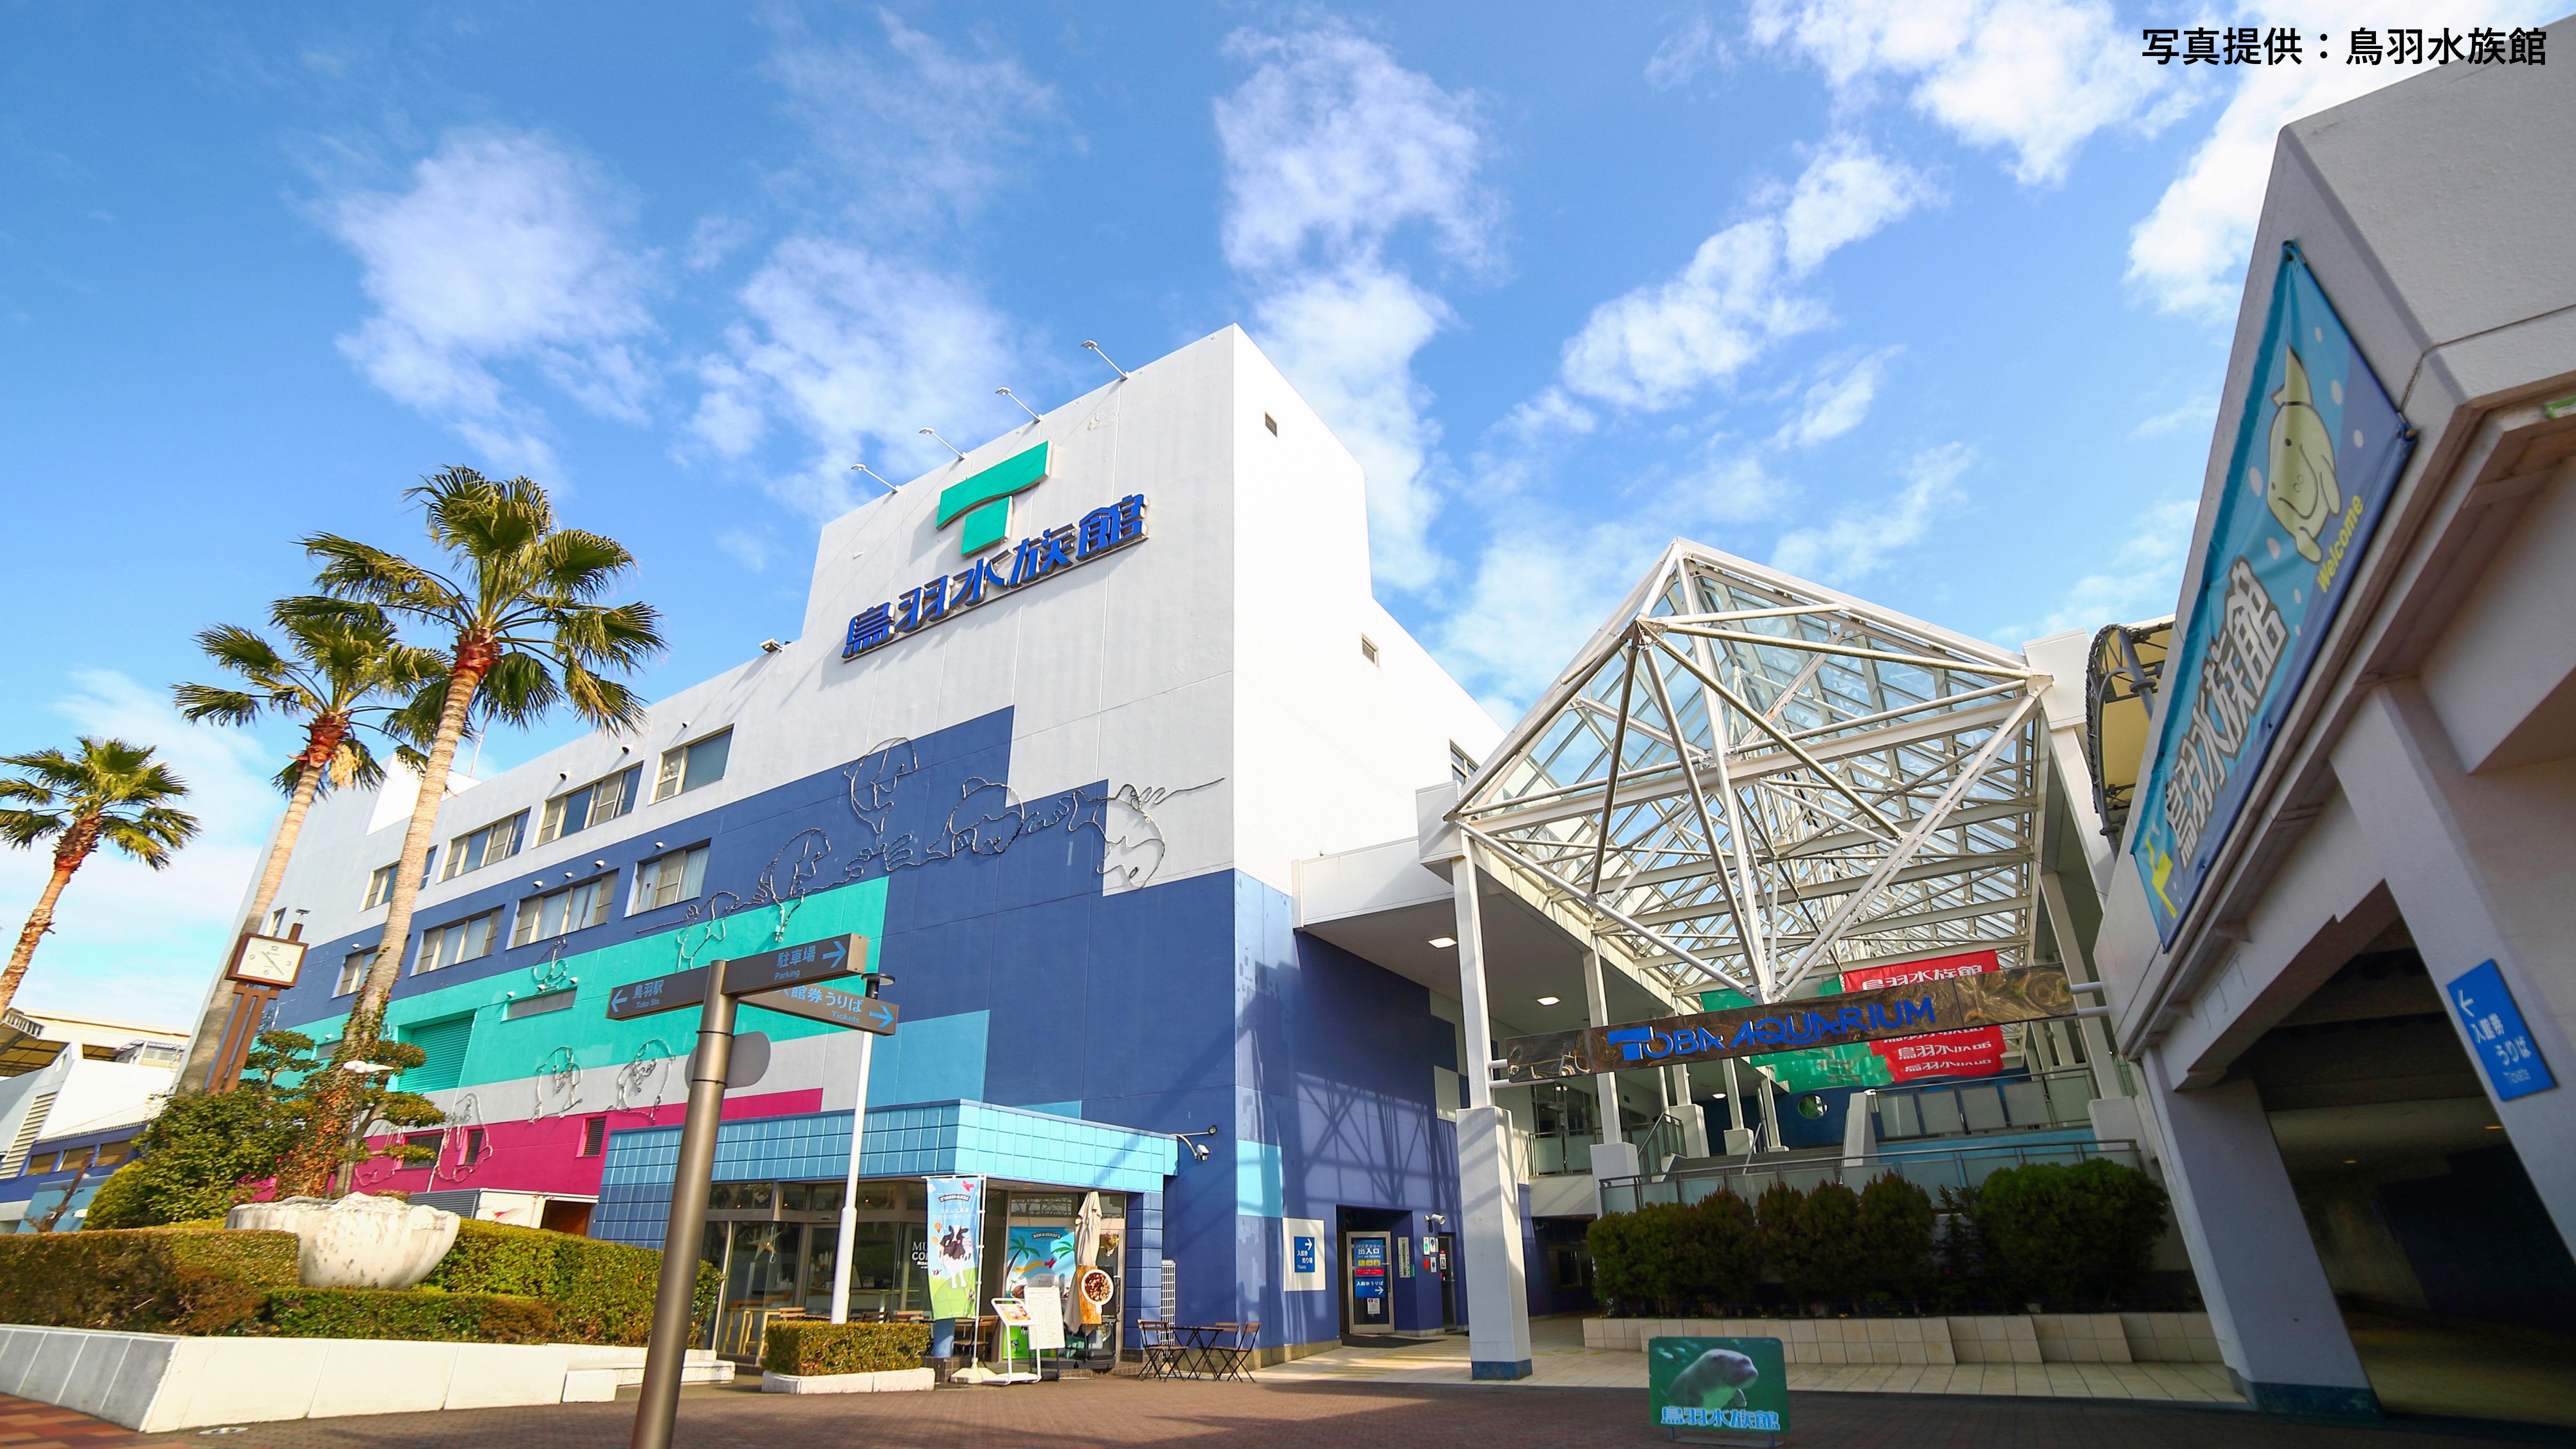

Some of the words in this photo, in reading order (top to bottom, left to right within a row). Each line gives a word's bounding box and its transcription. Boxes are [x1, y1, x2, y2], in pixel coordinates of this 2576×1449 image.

[2316, 494, 2364, 594] Welcome
[842, 493, 1150, 659] 鳥羽水族館
[2165, 557, 2289, 871] 鳥羽水族館
[777, 945, 816, 968] 駐車場
[774, 970, 800, 980] Parking
[632, 979, 664, 1000] 鳥羽駅
[831, 1011, 861, 1023] Tickets
[1607, 1026, 1726, 1061] TOBA
[1730, 997, 1936, 1048] AQUARIUM
[2496, 1035, 2531, 1066] うりば
[912, 1252, 927, 1261] CO
[1660, 1406, 1781, 1431] 鳥羽水族館
